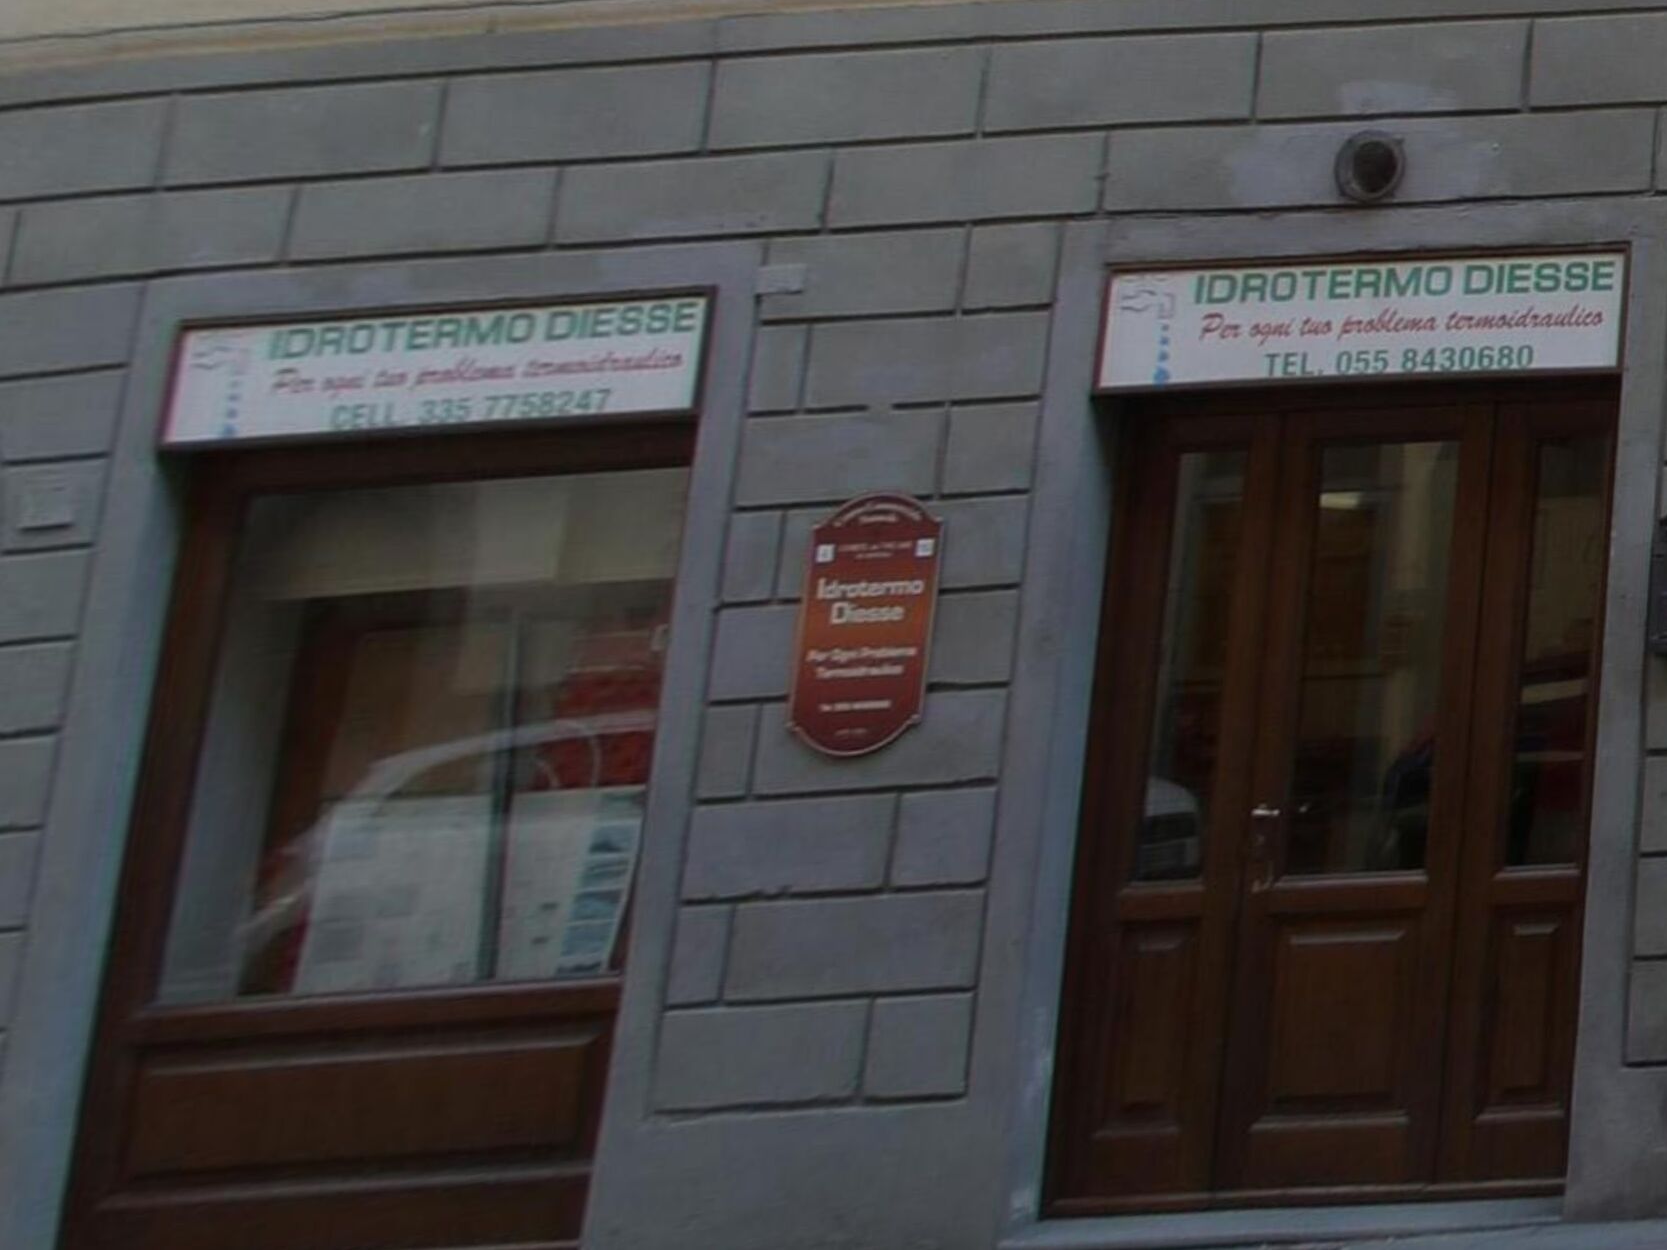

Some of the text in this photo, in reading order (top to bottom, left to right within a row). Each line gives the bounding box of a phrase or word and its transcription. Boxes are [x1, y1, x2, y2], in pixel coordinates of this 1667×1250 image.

[1194, 261, 1616, 304] IDROTERMO DIESSE
[270, 302, 699, 359] IDROTERMO DIESSE
[1199, 303, 1605, 346] Per ogni tuo problema termoidraulico
[1265, 344, 1534, 376] TEL. 055 8430680
[417, 397, 472, 425] 335
[484, 388, 612, 420] 7758247
[817, 578, 925, 600] Idrotermo
[831, 602, 905, 625] Diesse
